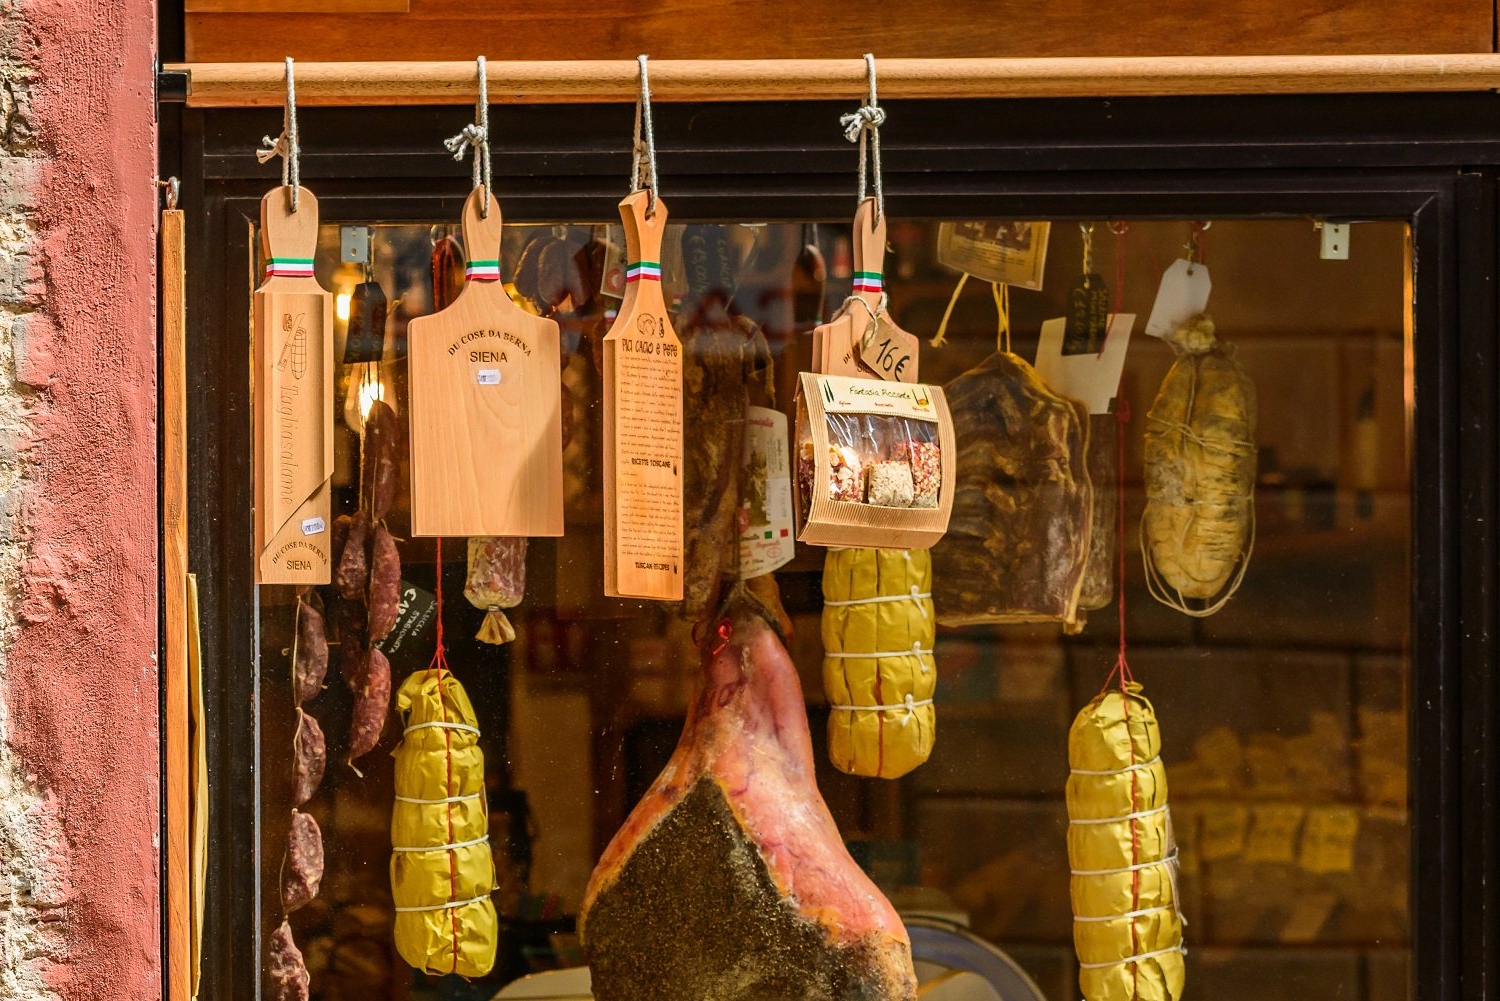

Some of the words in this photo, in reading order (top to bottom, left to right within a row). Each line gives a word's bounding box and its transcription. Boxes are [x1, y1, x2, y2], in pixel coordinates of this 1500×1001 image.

[447, 342, 461, 356] DU
[461, 329, 486, 345] COSE
[488, 329, 501, 339] DA
[503, 332, 532, 357] BERNA
[469, 351, 508, 363] SIENA
[650, 459, 671, 469] TOSCANE
[286, 560, 312, 571] SIENA
